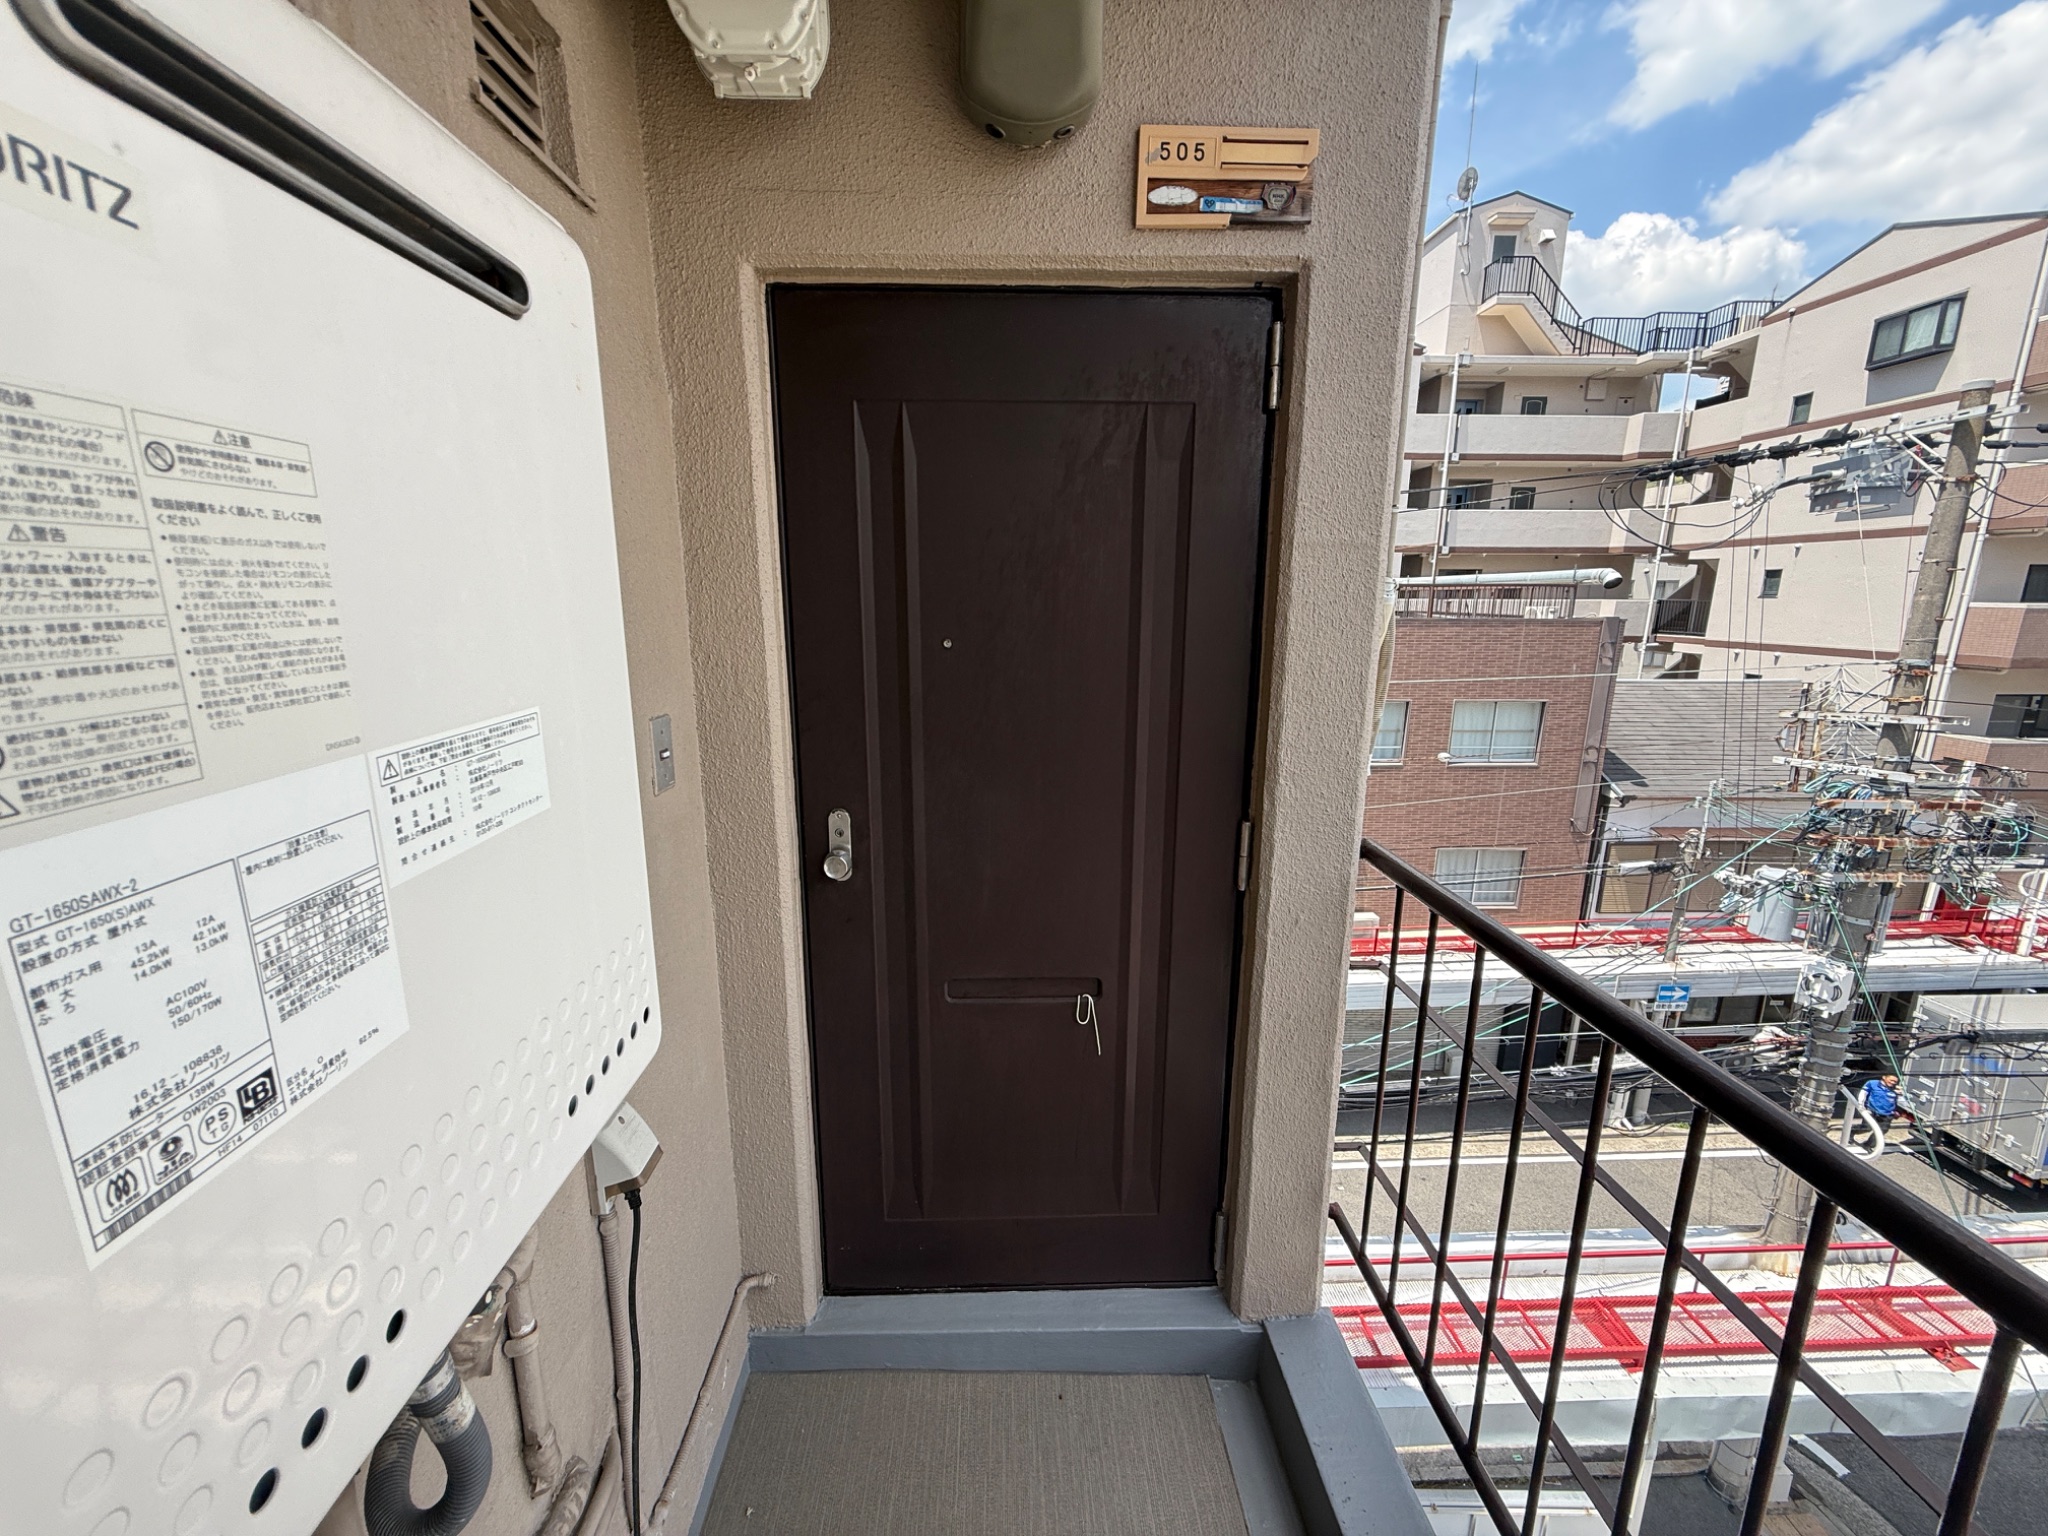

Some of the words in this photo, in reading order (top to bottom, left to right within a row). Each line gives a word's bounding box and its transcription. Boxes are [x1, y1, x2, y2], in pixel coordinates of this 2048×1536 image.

[1160, 142, 1205, 161] 505
[228, 434, 252, 449] 注意
[30, 525, 66, 542] 警告
[9, 878, 139, 934] GT-1650SAWX-2
[16, 933, 50, 957] 型式
[55, 896, 156, 942] GT-1650(S)AWX
[20, 933, 99, 974] 設置の方式
[106, 914, 148, 940] 屋外式
[29, 960, 103, 1000] 都市ガス用
[130, 945, 171, 970] 45.2kW
[192, 921, 227, 942] 42.1kW
[133, 957, 173, 982] 14.0kW
[195, 931, 229, 954] 13.0kW
[135, 938, 157, 955] 13A
[196, 914, 216, 929] 12A
[47, 1028, 108, 1066] 定格電圧
[166, 978, 208, 1007] AC100V
[51, 1035, 125, 1081] 定格周波数
[168, 989, 213, 1019] 50/60Hz
[55, 1040, 141, 1094] 定格消費電力
[171, 996, 223, 1030] 150/170W
[129, 1052, 231, 1121] 株式会社ノーリツ
[134, 1078, 167, 1104] 16.12
[189, 1079, 216, 1101] 139W
[217, 1135, 243, 1157] HF14
[253, 1108, 279, 1131] 07110
